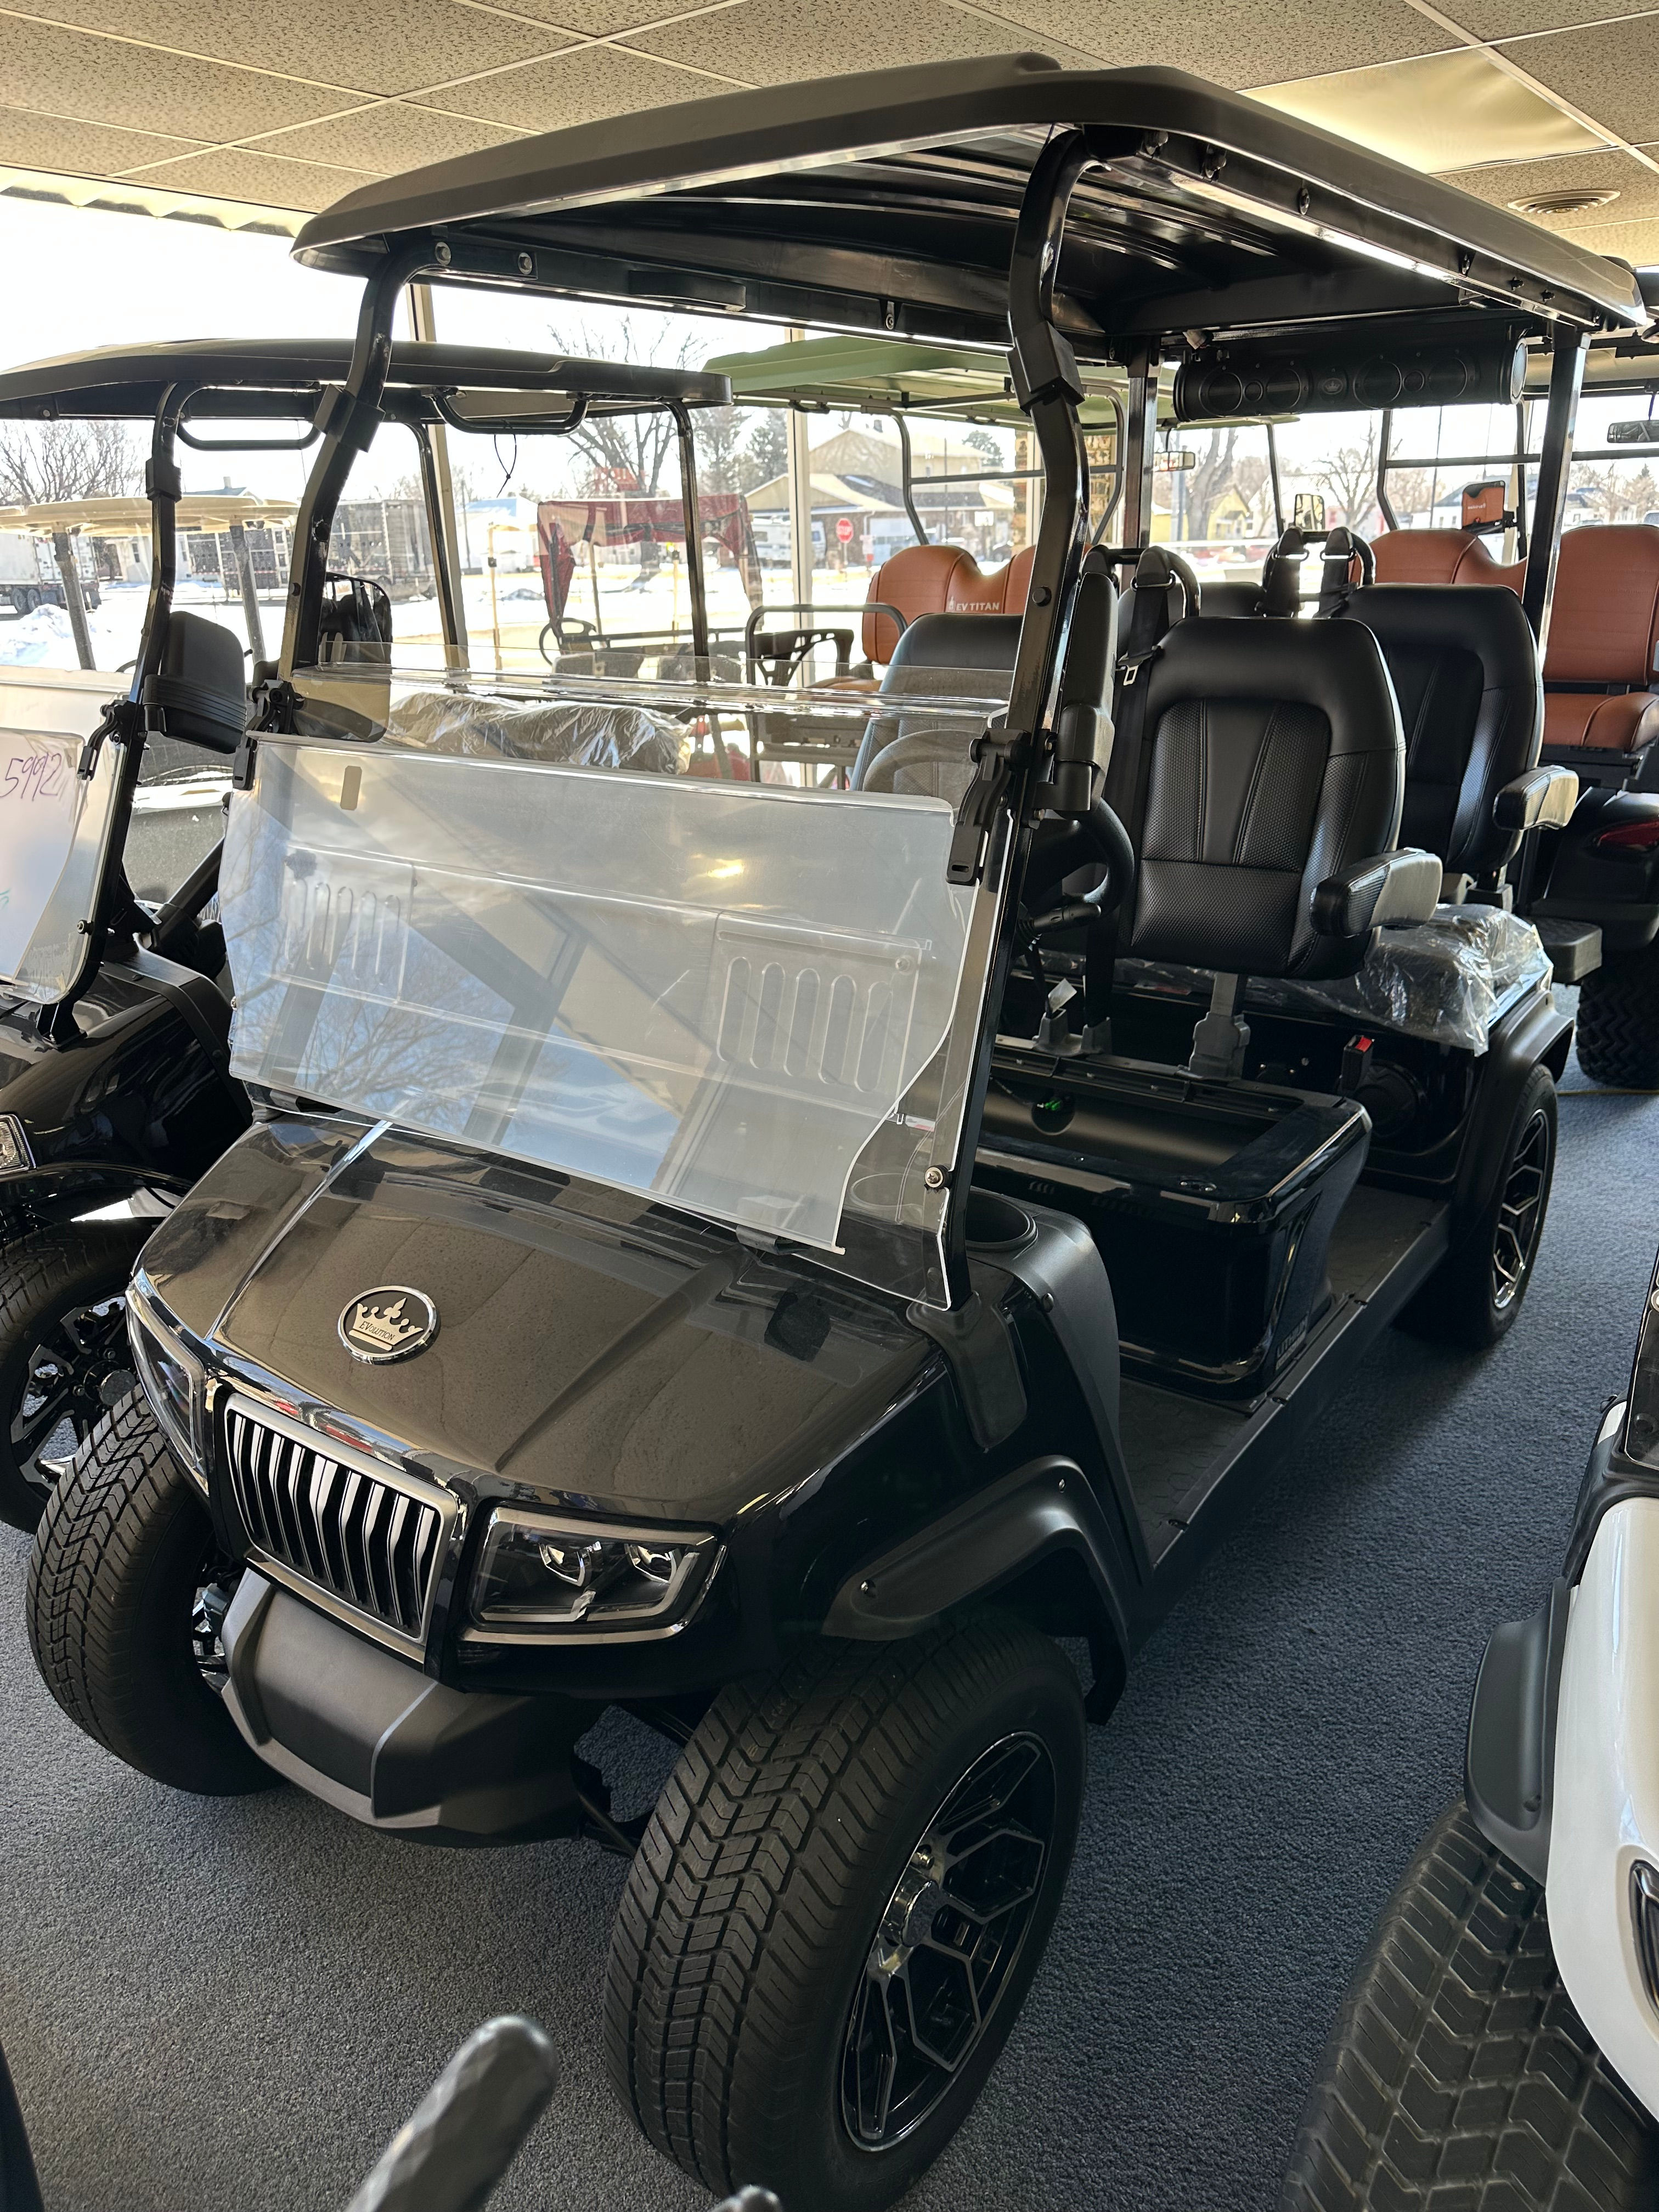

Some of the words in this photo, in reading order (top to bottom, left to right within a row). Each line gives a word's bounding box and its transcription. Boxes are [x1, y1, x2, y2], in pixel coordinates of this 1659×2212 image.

[837, 525, 851, 536] STOP
[956, 603, 968, 611] EV
[969, 602, 1000, 611] TITAN
[0, 751, 61, 802] 5992
[359, 1321, 395, 1341] EVOLUTION
